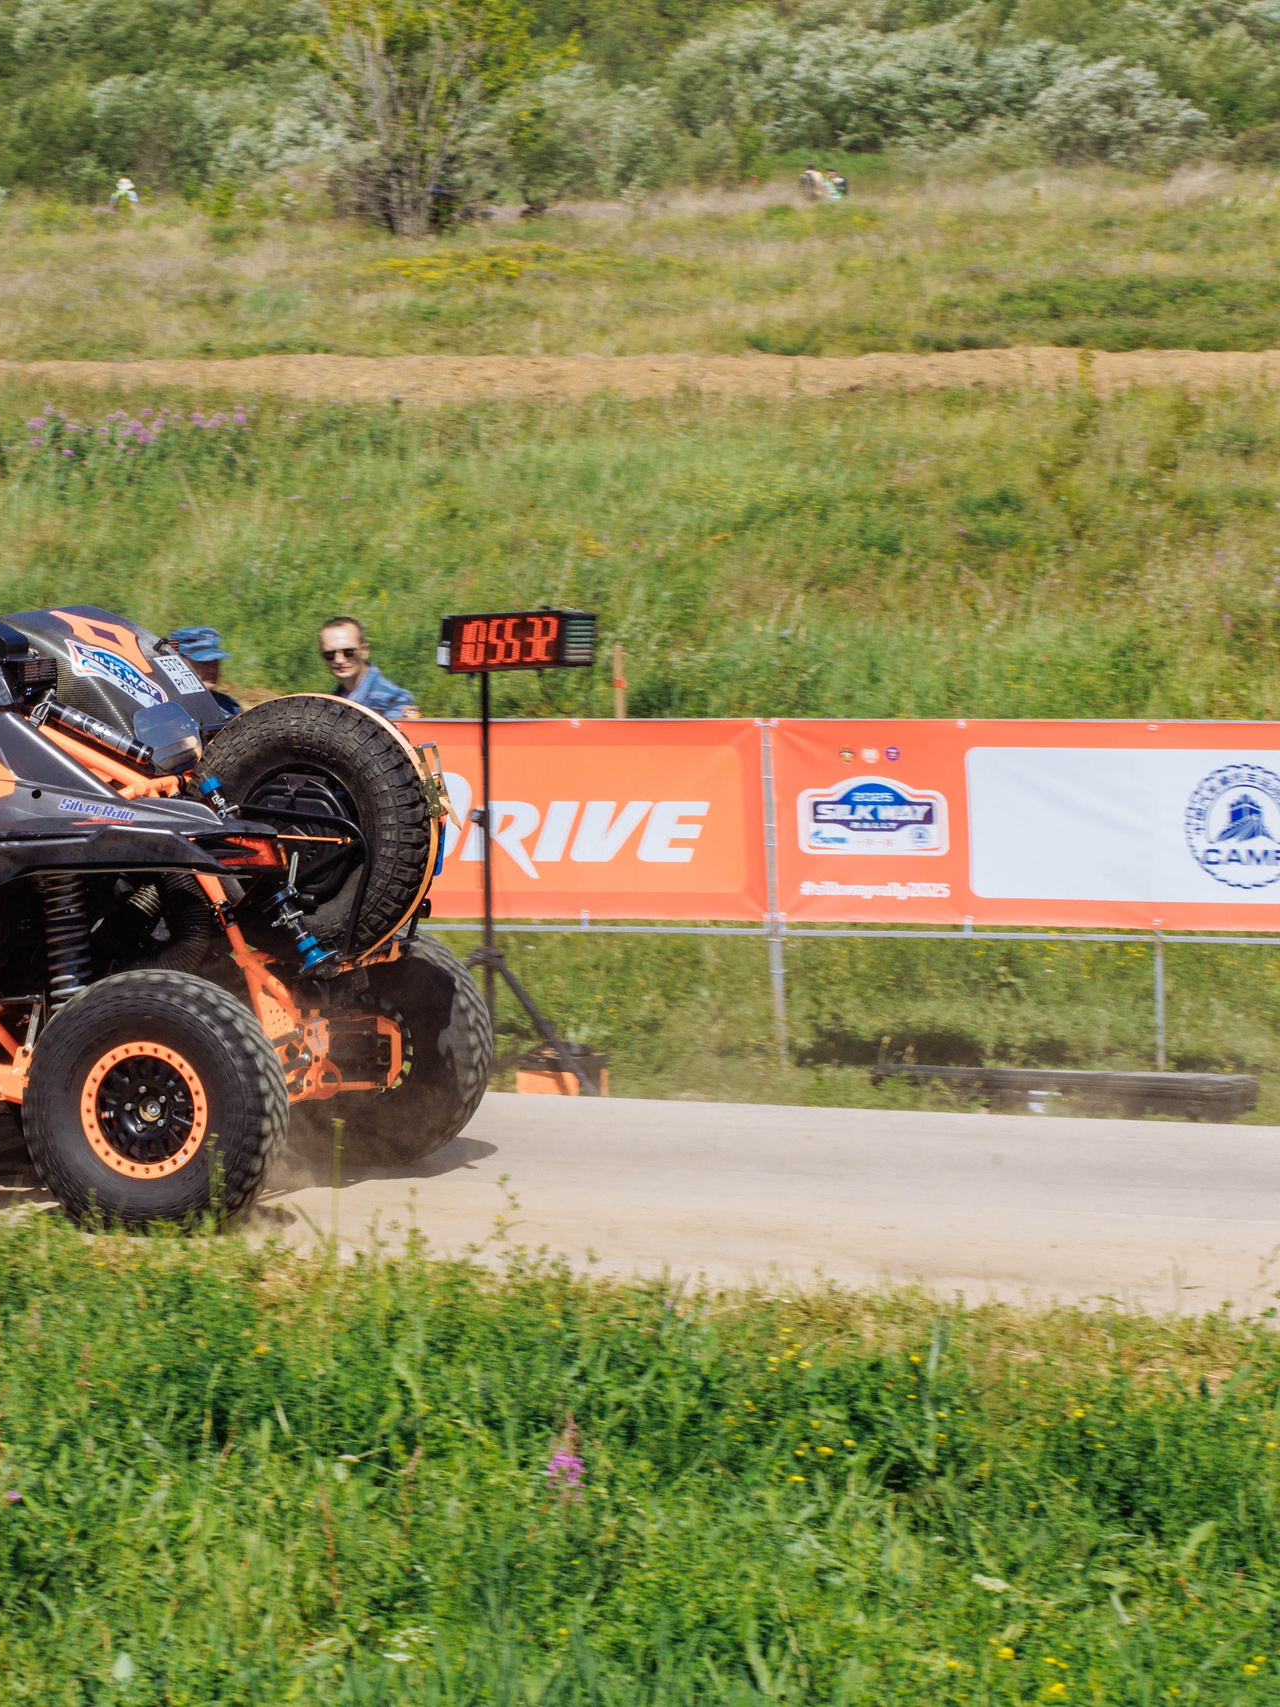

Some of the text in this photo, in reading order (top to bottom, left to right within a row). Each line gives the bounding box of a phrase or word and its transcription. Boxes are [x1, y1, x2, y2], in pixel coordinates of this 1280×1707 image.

[80, 648, 159, 696] SILK WAY
[119, 680, 138, 698] 212
[814, 804, 932, 821] SILK WAY
